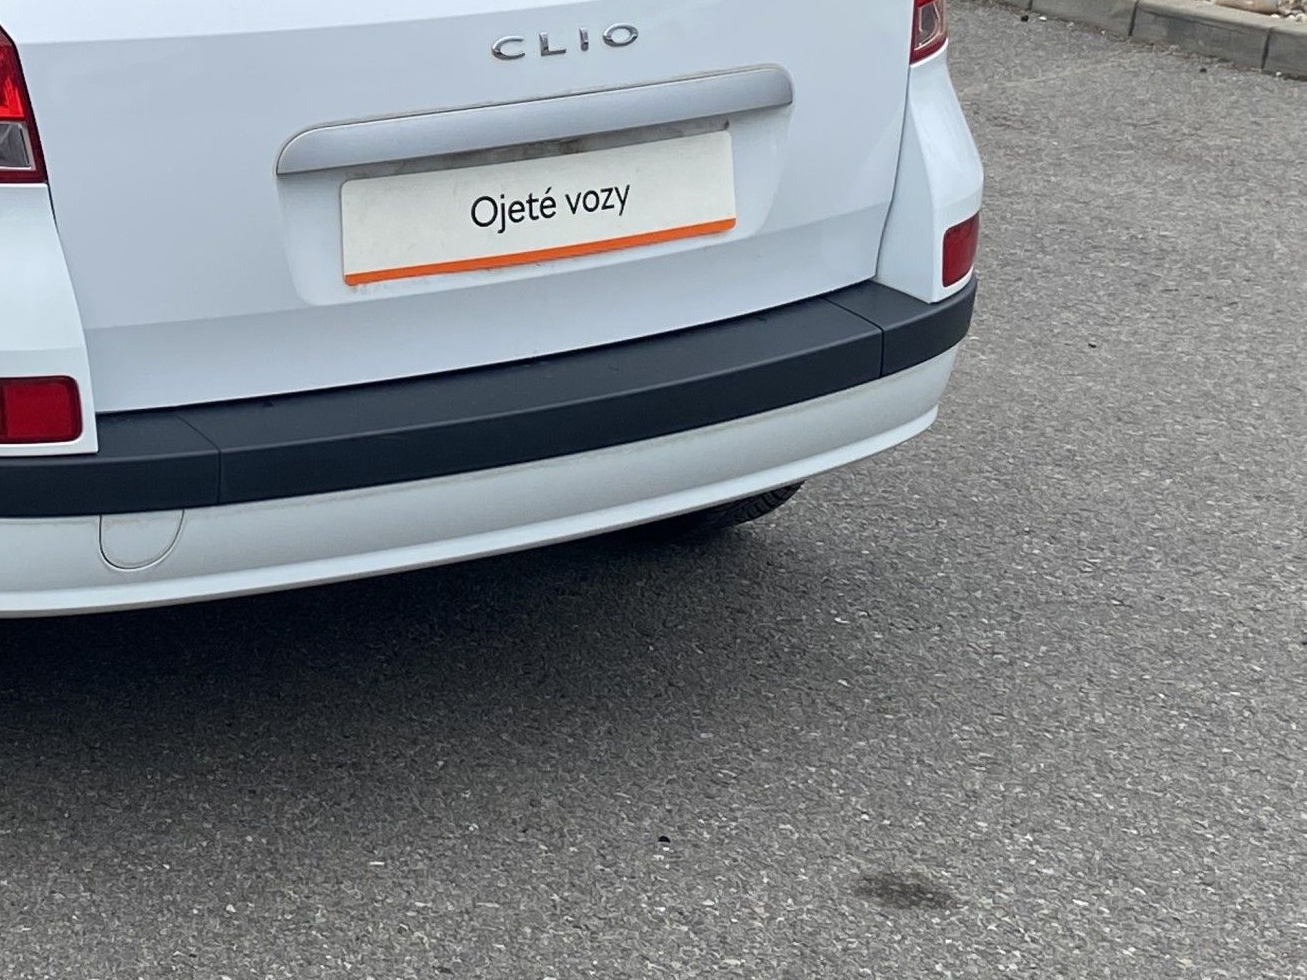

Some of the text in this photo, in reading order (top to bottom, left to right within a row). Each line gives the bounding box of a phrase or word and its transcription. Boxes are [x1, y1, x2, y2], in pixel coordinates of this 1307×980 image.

[491, 22, 639, 61] CLIO
[470, 184, 630, 234] Ojeté vozy
